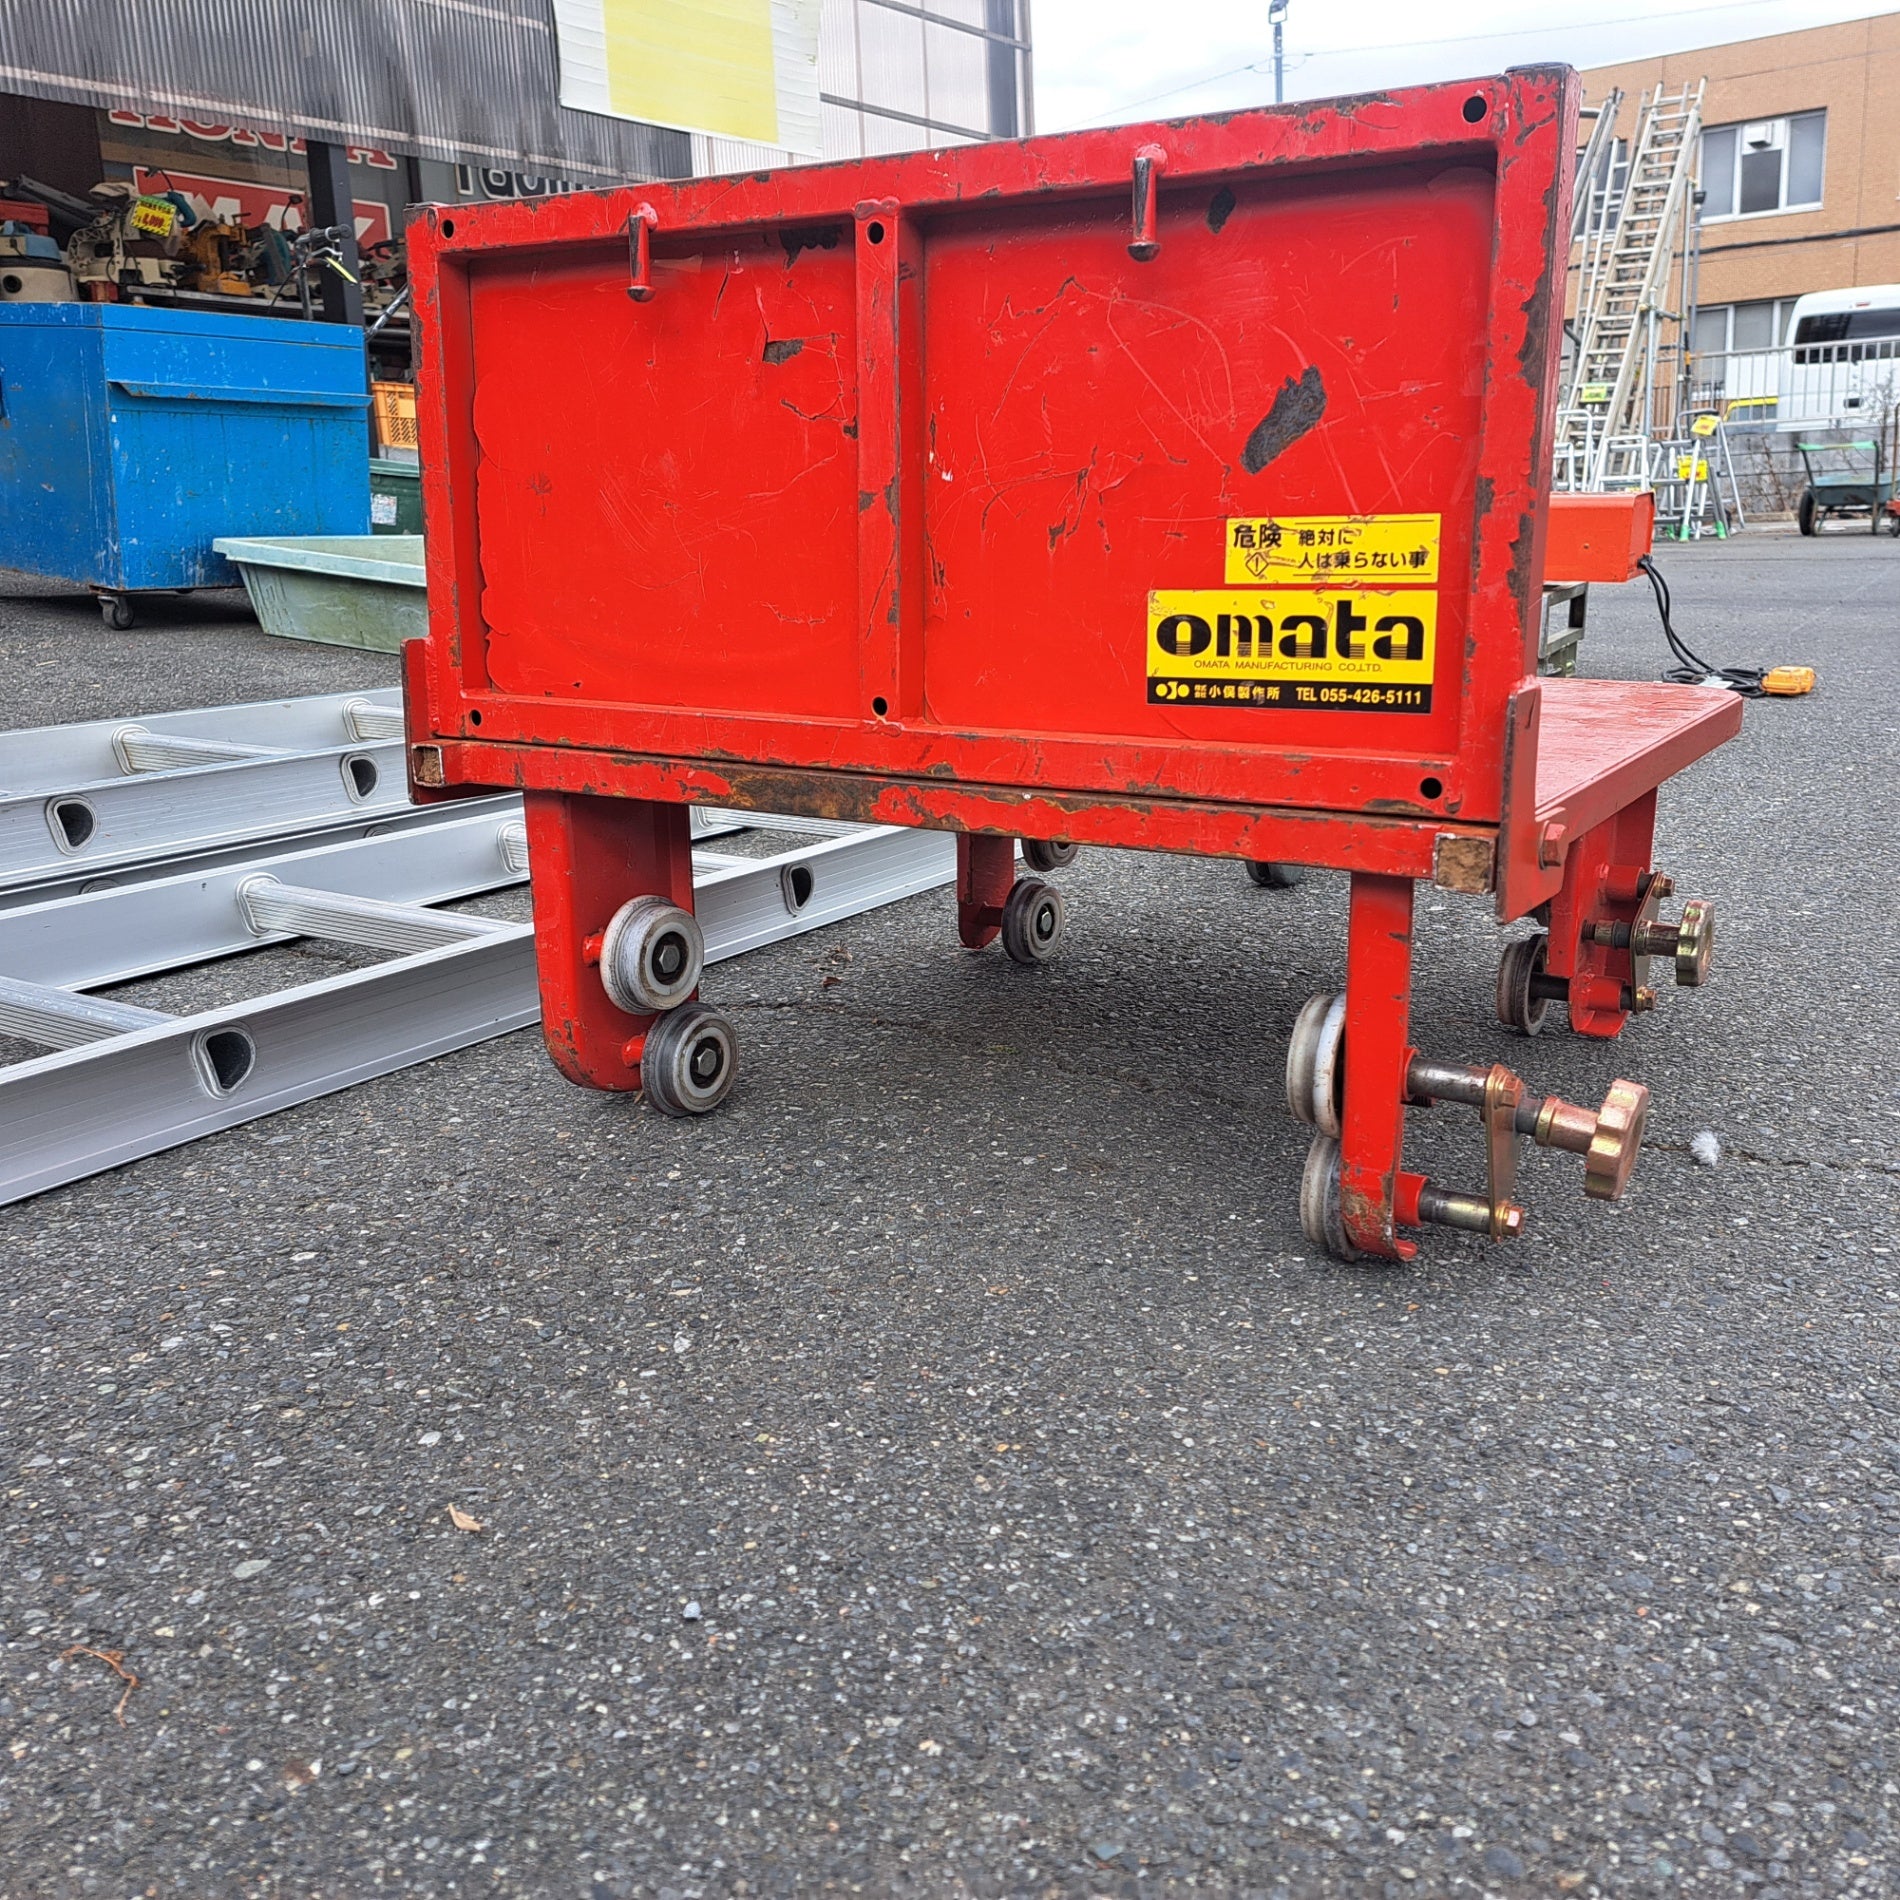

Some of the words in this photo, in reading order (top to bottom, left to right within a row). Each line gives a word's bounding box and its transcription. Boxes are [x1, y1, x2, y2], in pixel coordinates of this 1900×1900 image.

[1233, 524, 1281, 548] 危険
[1298, 528, 1354, 546] 絶対に
[1298, 551, 1427, 569] 人は乗らない事
[1156, 600, 1424, 661] omata
[1194, 660, 1230, 669] OMATA
[1235, 660, 1333, 671] MANUFACTURING
[1296, 687, 1318, 701] TEL
[1320, 687, 1421, 705] 055-426-5111
